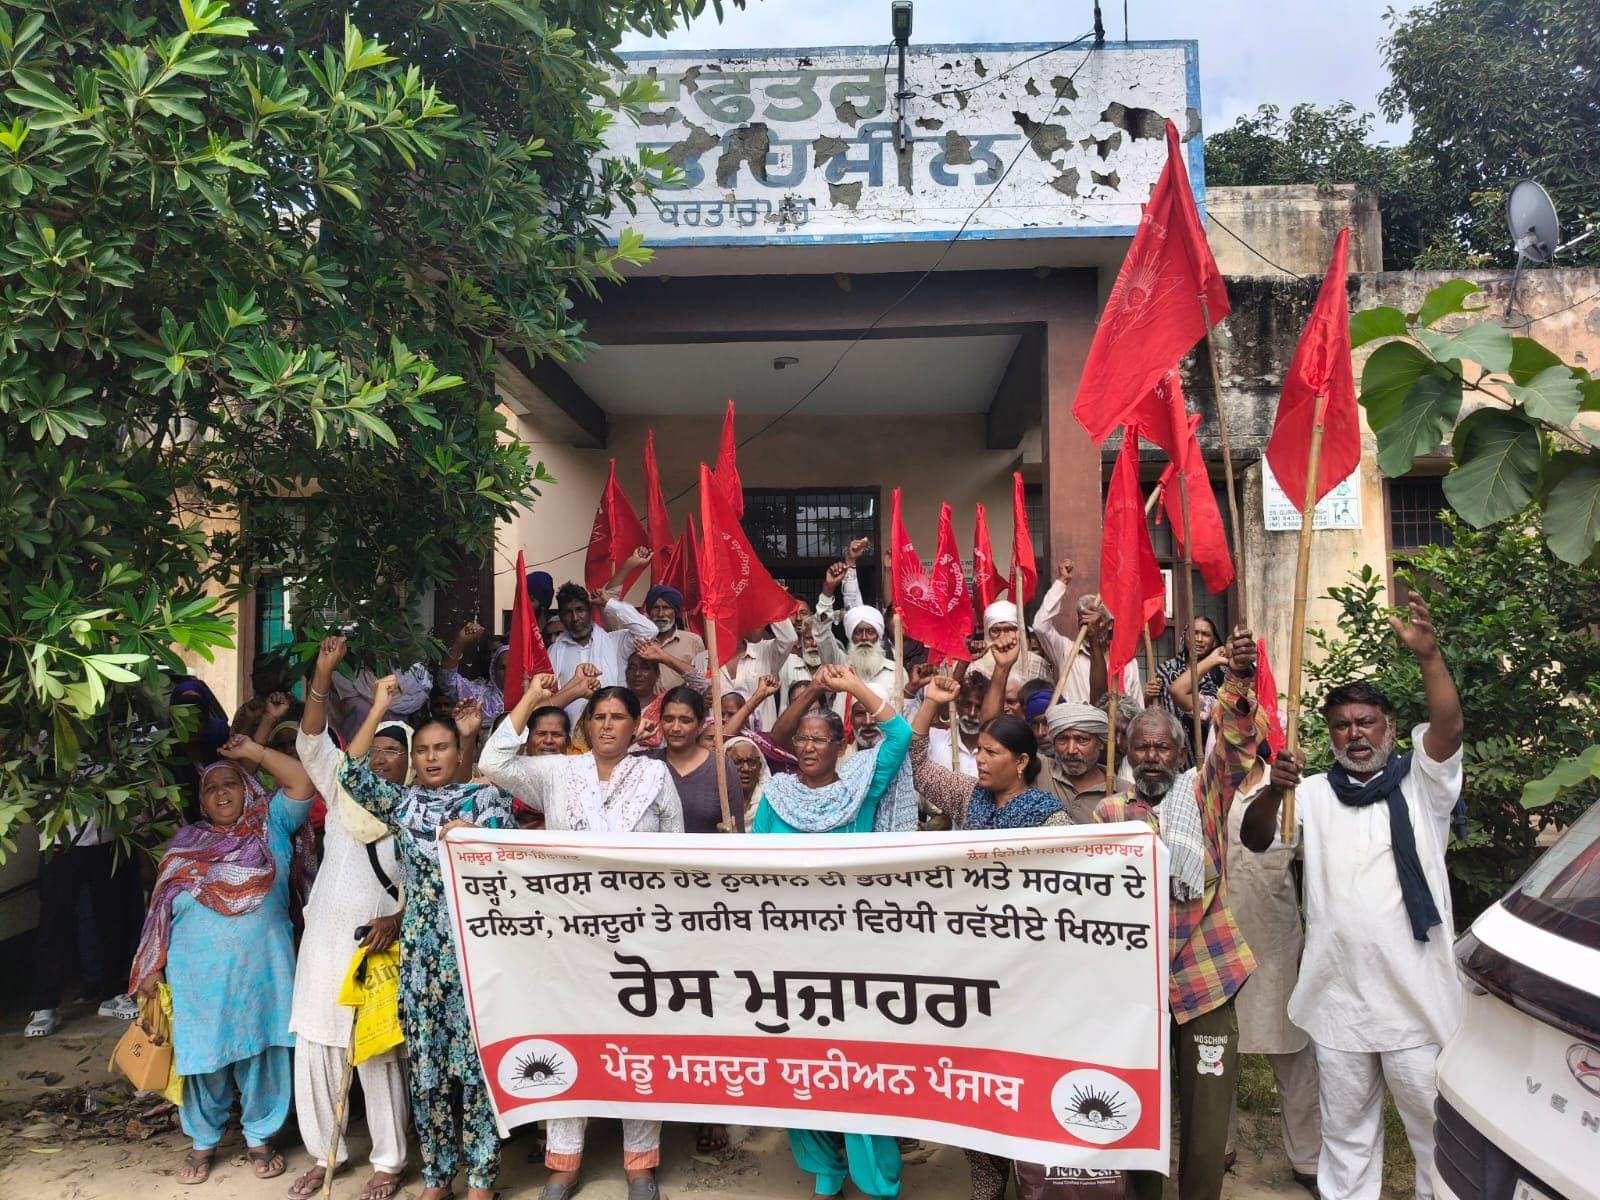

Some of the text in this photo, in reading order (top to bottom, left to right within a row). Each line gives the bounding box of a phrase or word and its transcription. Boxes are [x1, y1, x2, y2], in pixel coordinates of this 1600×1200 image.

[457, 850, 493, 866] ਮਜ਼ਦੂਰ
[522, 871, 592, 895] ਬਾਰਸ਼
[598, 870, 666, 890] ਕਾਰਨ
[670, 869, 711, 888] ਹੋਏ
[717, 872, 809, 893] ਨੁਕਸਾਨ
[814, 871, 847, 887] ਦੀ
[854, 865, 954, 888] ਭਰਪਾਈ
[963, 862, 1013, 890] ਅਤੇ
[1019, 869, 1115, 898] ਸਰਕਾਰ
[1121, 865, 1148, 899] ਦੇ
[466, 899, 1151, 951] ਦਲਿਤਾਂ, ਮਜ਼ਦੂਰਾਂ ਤੇ ਗਰੀਬ ਕਿਸਾਨਾਂ ਵਿਰੋਧੀ ਰਵੱਈਏ ਖਿਲਾਫ਼
[610, 952, 1000, 1034] ਰੋਸ ਮੁਜ਼ਾਹਰਾ
[1193, 1034, 1228, 1045] MOSCHINO
[600, 1043, 1025, 1111] ਪੇਂਡੂ ਮਜ਼ਦੂਰ ਯੂਨੀਅਨ ਪੰਜਾਬ
